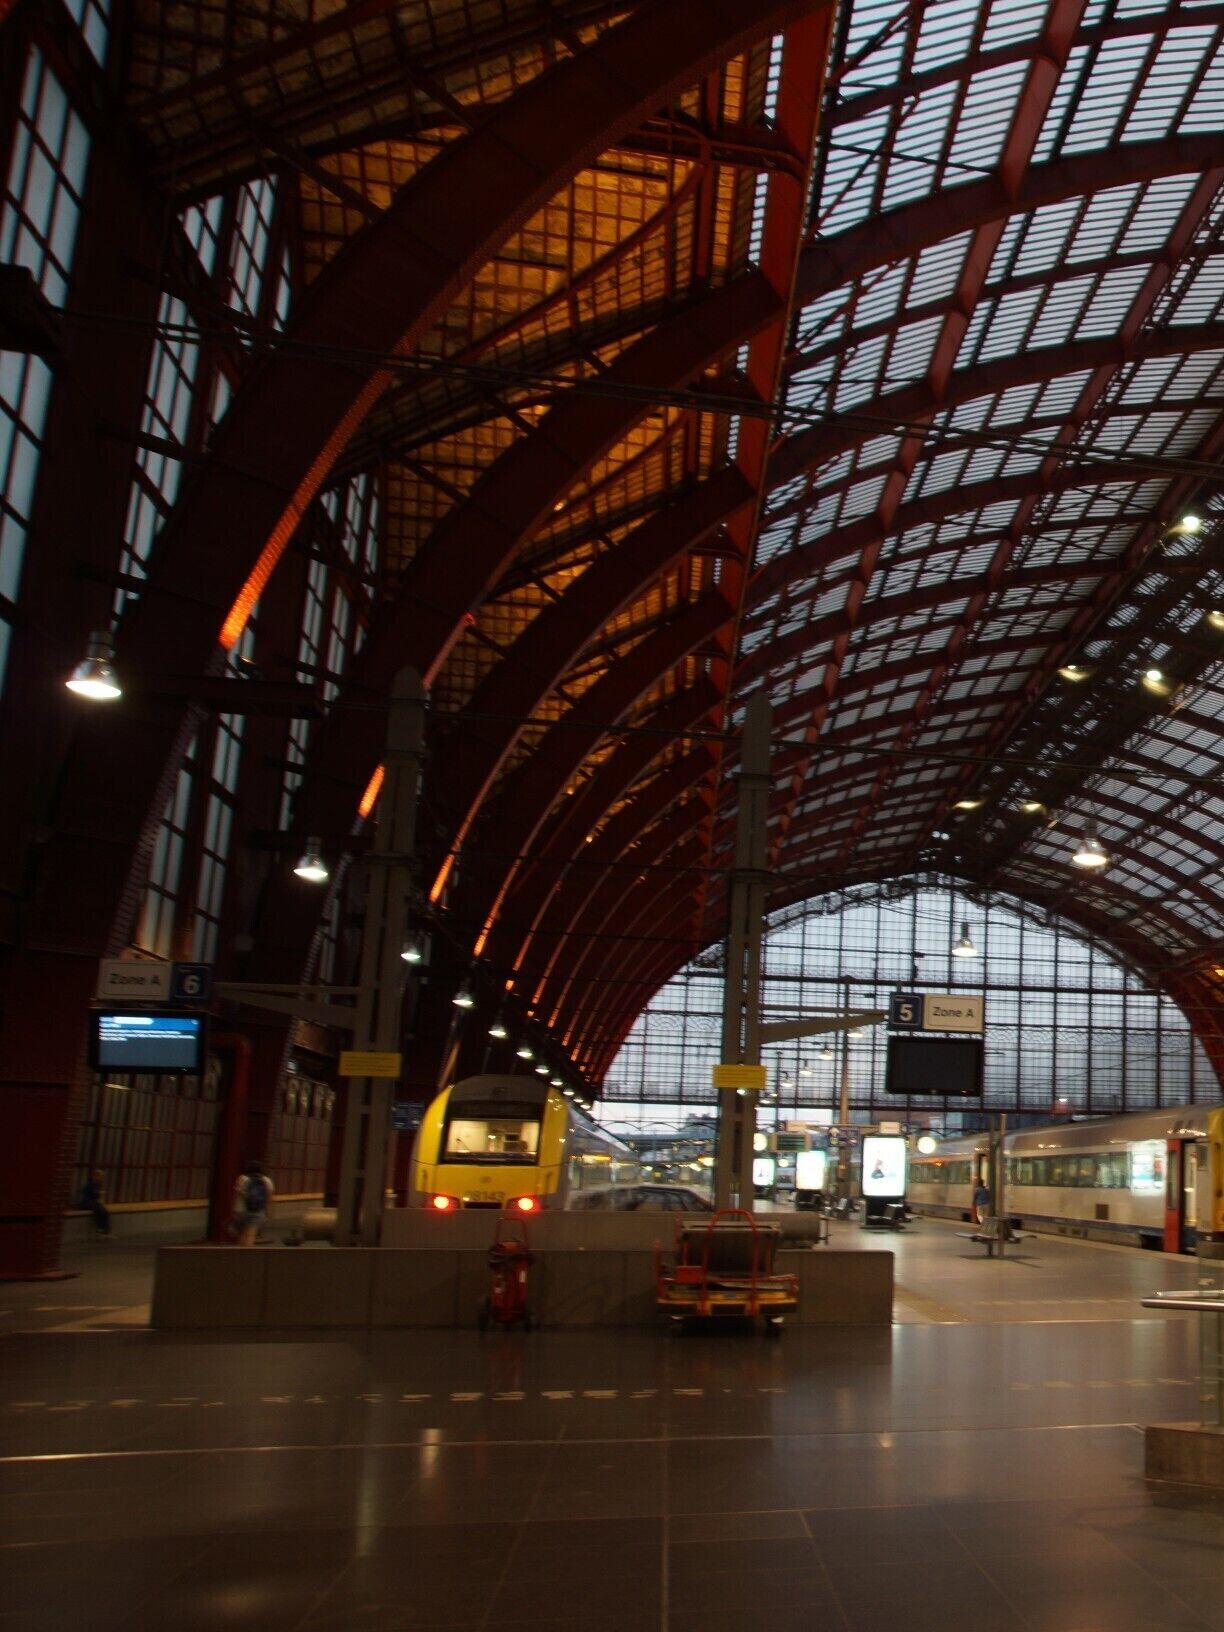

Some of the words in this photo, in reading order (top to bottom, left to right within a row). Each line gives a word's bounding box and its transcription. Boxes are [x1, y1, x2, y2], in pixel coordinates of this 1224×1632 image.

[182, 974, 201, 995] 6
[899, 1003, 914, 1022] 5
[932, 1006, 962, 1018] Zone
[965, 1008, 975, 1018] A
